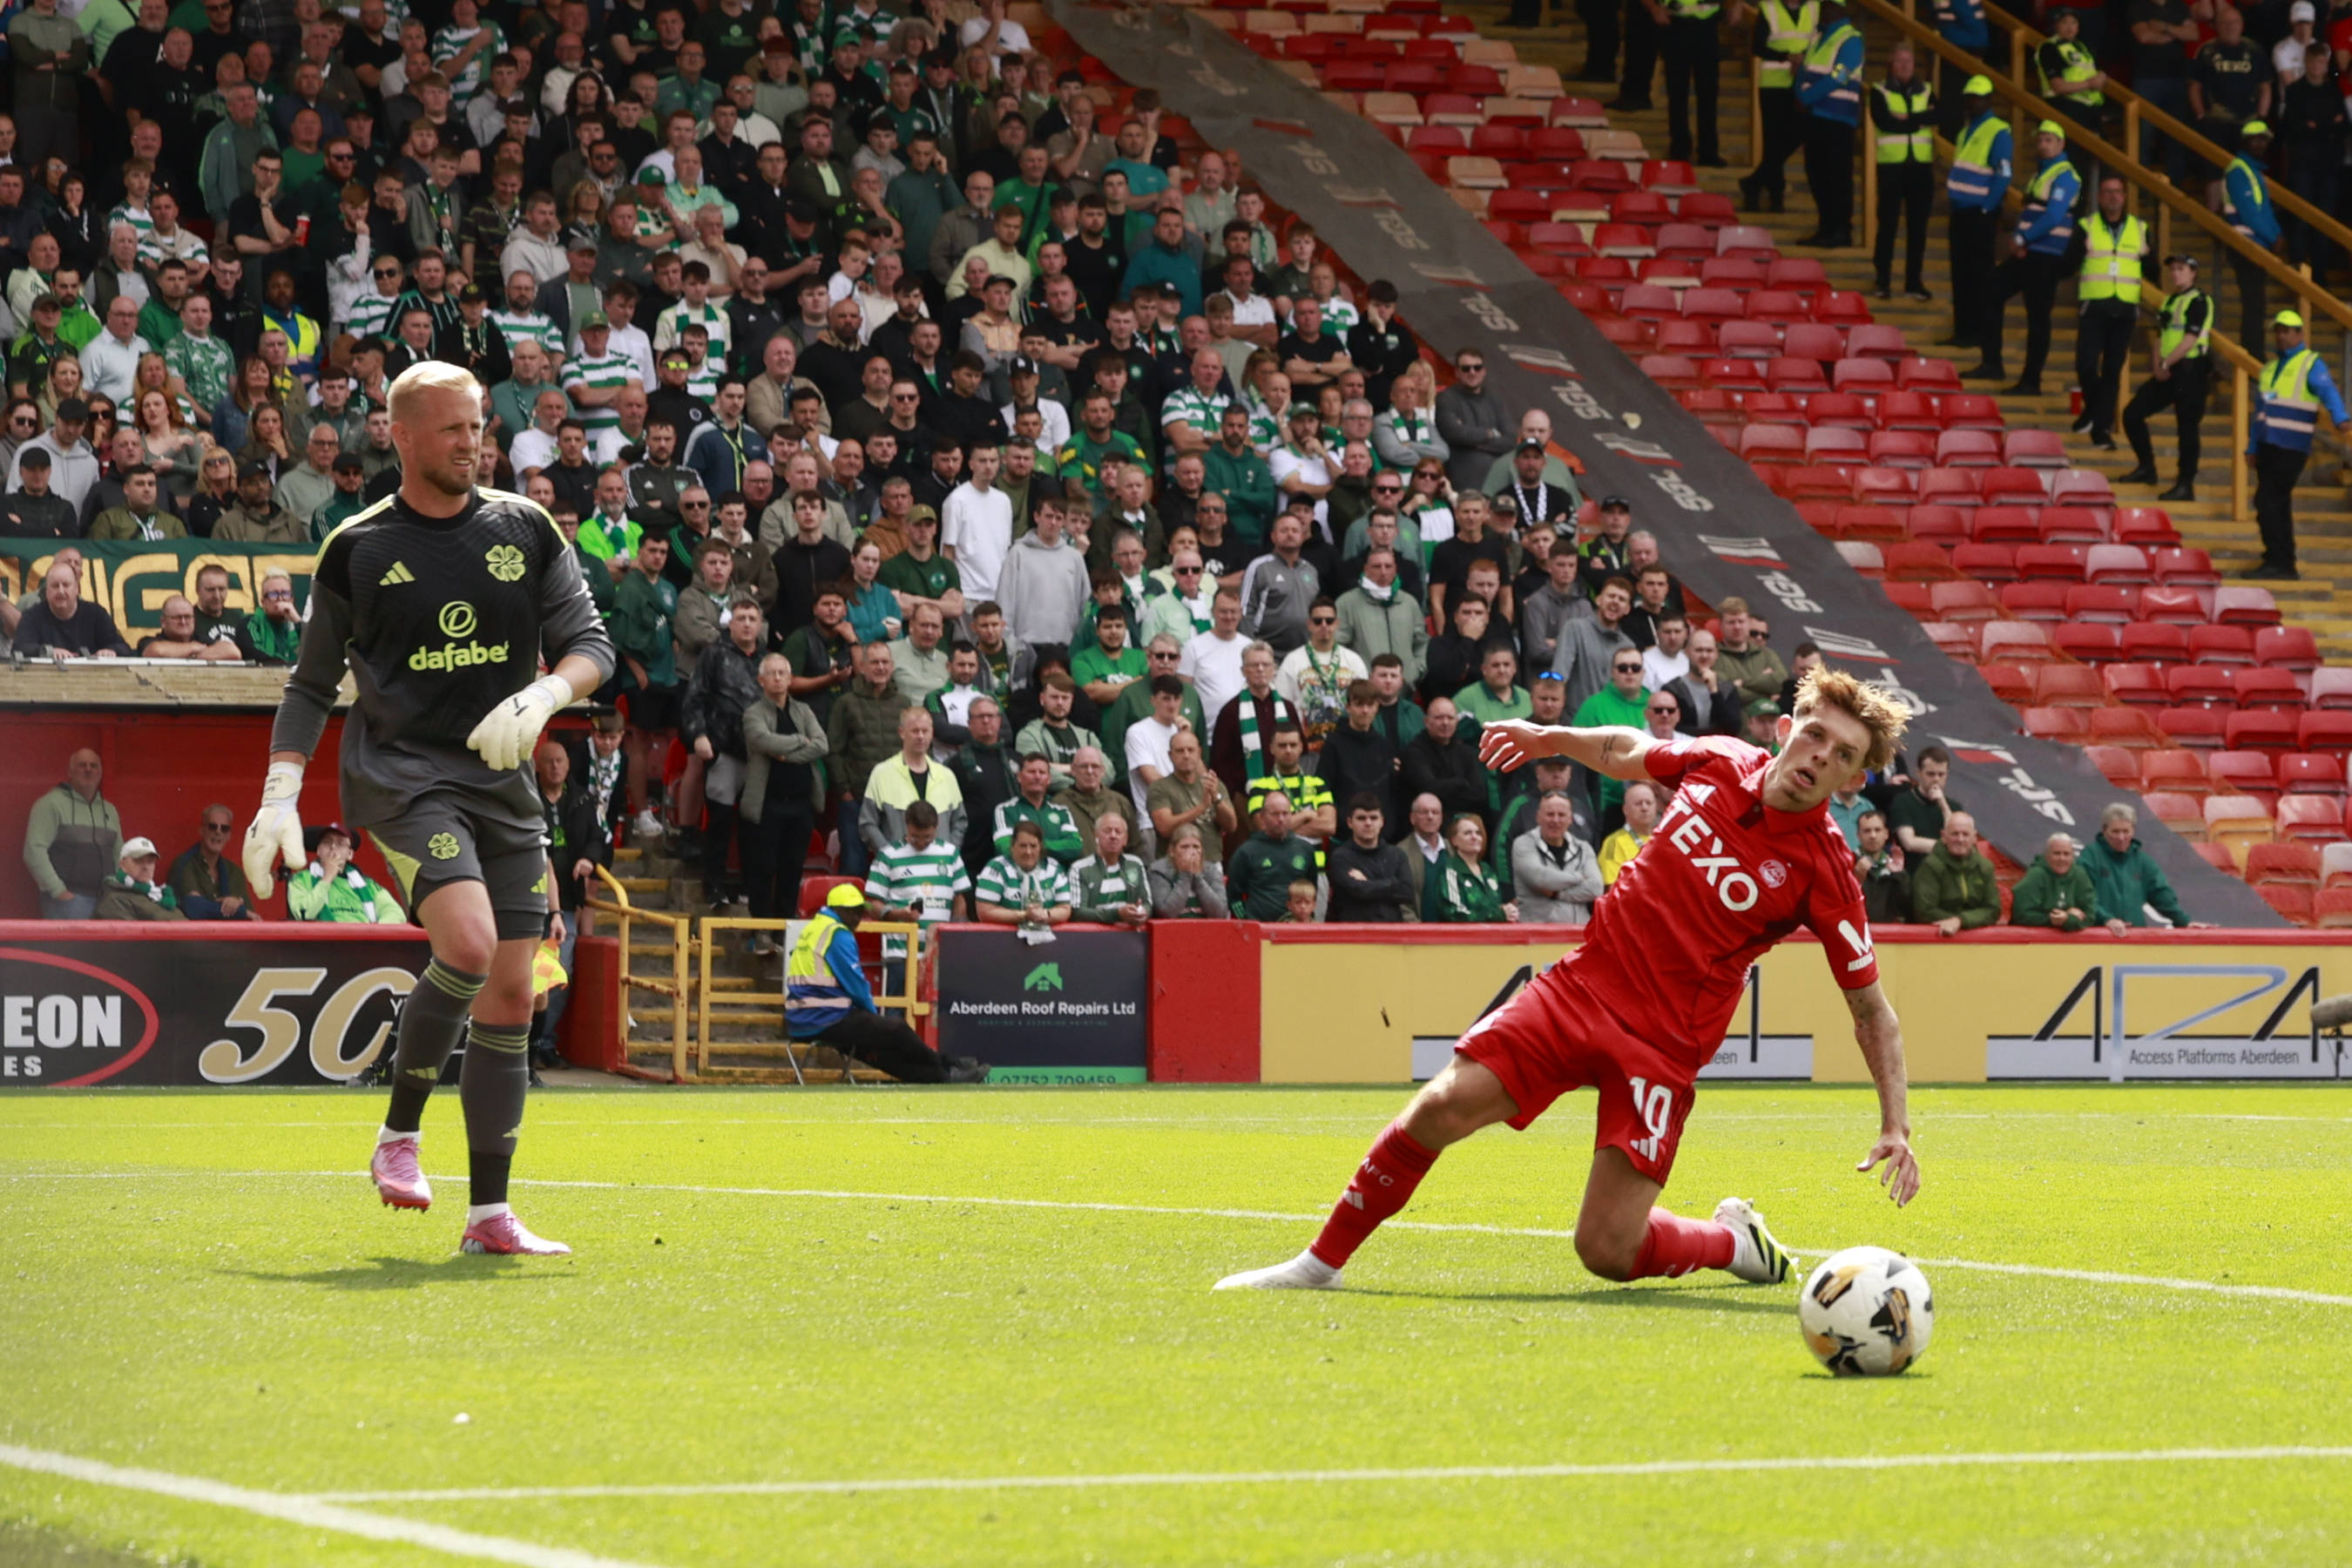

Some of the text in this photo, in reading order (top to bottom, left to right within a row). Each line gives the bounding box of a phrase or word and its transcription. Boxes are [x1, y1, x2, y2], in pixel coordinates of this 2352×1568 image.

[1551, 380, 1614, 420] SGL
[1648, 469, 1714, 512] SGL
[1756, 571, 1824, 614] SGL
[408, 639, 510, 673] dafabet
[1653, 796, 1759, 912] TEXO
[3, 994, 122, 1049] EON
[199, 967, 419, 1084] 50
[950, 1001, 1136, 1017] Aberdeen Roof Repairs Ltd
[3, 1056, 43, 1078] ES
[2130, 1048, 2300, 1064] Access Platforms Aberdeen
[1628, 1076, 1673, 1139] 10
